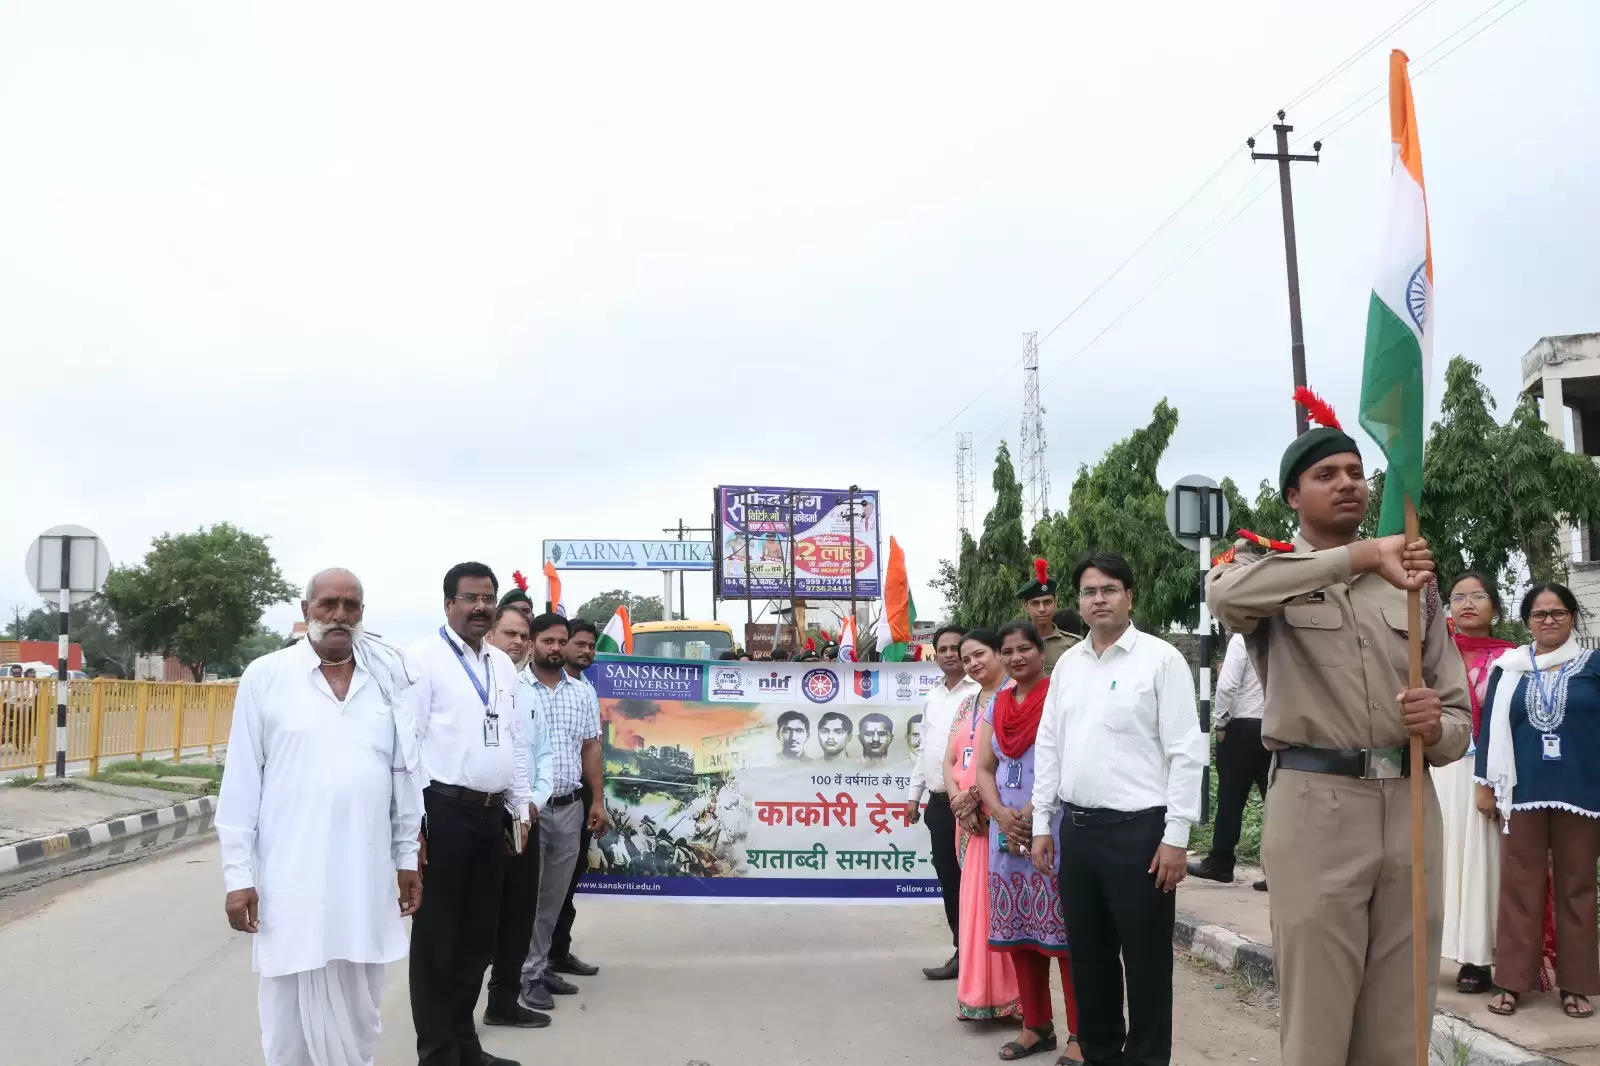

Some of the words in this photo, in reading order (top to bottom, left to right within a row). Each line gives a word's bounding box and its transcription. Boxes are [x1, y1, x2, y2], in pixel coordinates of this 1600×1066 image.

[565, 543, 634, 560] AARNA
[642, 544, 713, 561] VATIKA
[795, 541, 817, 561] 2
[820, 546, 867, 561] लाख
[605, 664, 700, 681] SANSKRITI
[758, 672, 791, 689] nirf
[613, 680, 692, 690] UNIVERSITY
[811, 775, 831, 786] 100
[845, 774, 879, 786] वर्षगांठ
[881, 774, 892, 786] के
[755, 792, 858, 827] काकोरी
[866, 793, 910, 834] ट्रेन
[746, 843, 828, 870] शताब्दी
